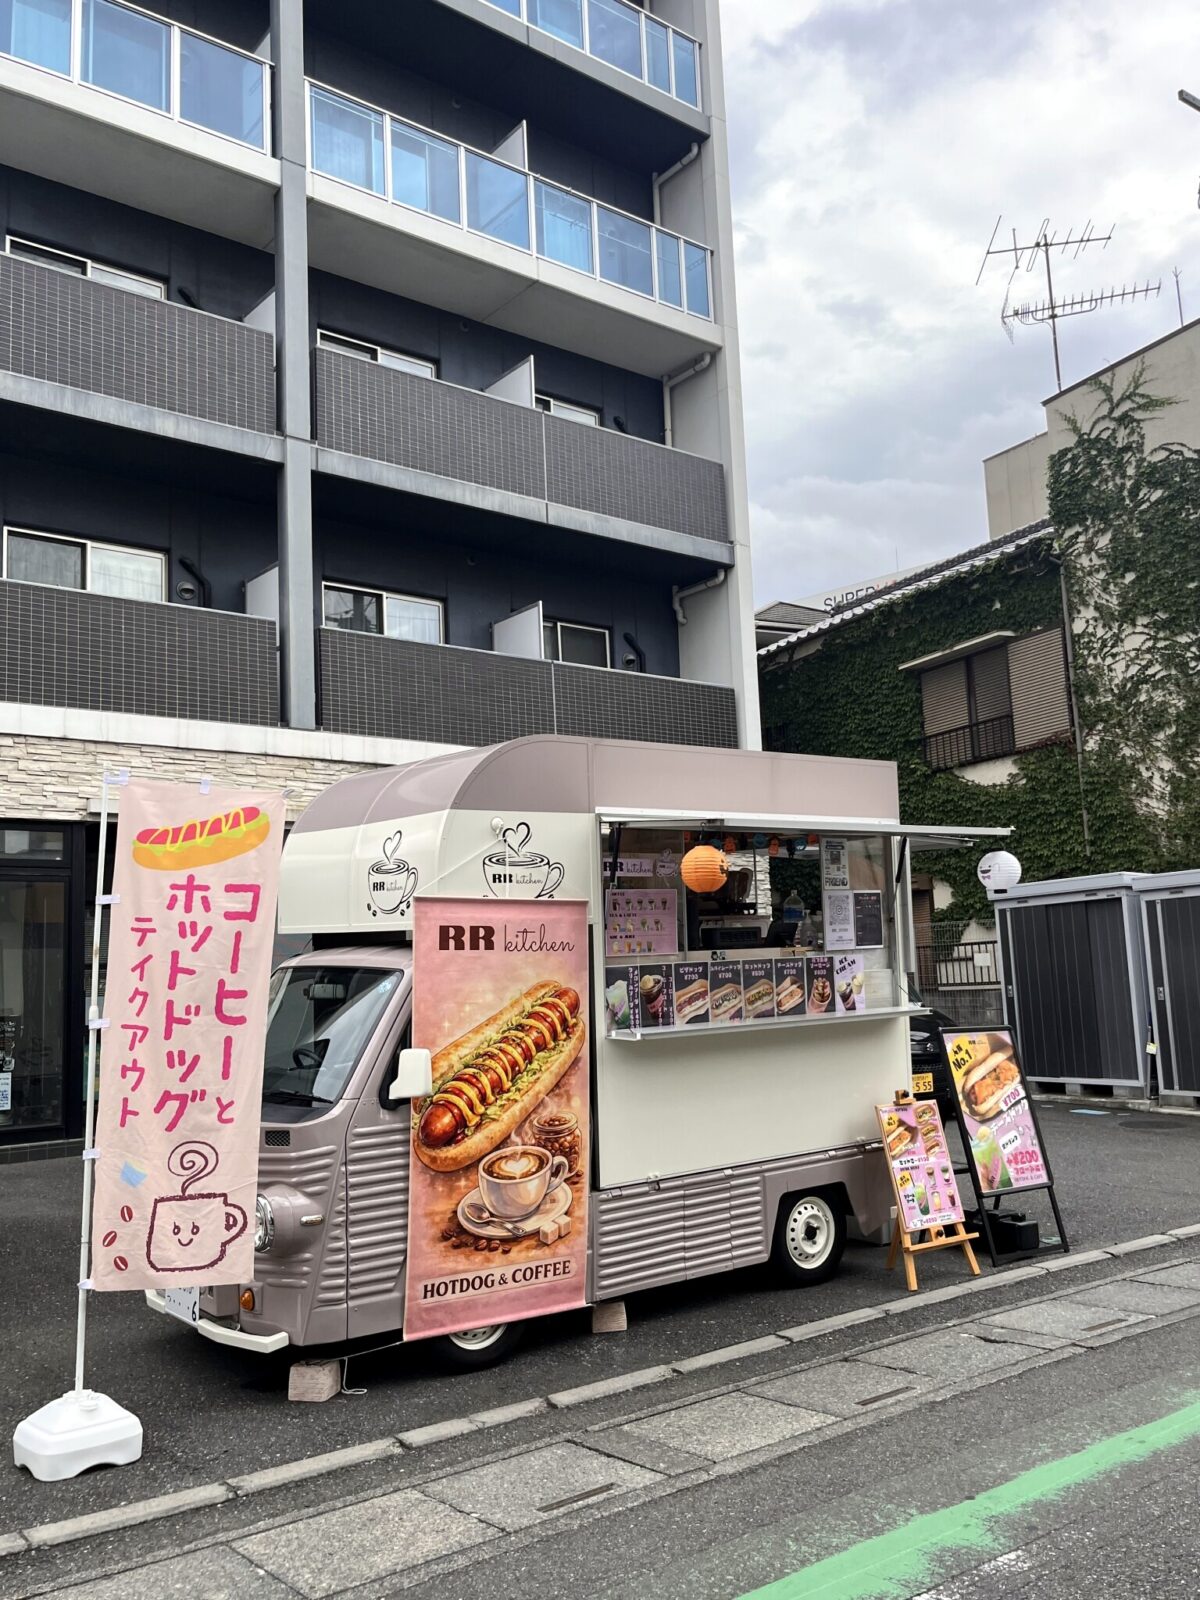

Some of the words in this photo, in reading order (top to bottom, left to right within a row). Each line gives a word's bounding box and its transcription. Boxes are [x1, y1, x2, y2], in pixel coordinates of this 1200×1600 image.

[626, 861, 652, 874] kitchen
[373, 881, 385, 892] RR
[386, 881, 403, 892] kitchen
[492, 873, 513, 884] RR
[515, 873, 544, 885] kitchen
[439, 925, 496, 951] RR
[504, 923, 575, 953] kitchen
[835, 959, 857, 975] CREAM
[838, 956, 848, 966] ICE
[153, 874, 213, 1132] ホットドッグ
[214, 883, 261, 1125] コーヒーと
[119, 916, 158, 1128] テイクアウト
[952, 1049, 973, 1072] No.1
[1002, 1088, 1021, 1107] ¥700
[423, 1273, 495, 1300] HOTDOG
[498, 1273, 509, 1286] &
[511, 1260, 571, 1284] COFFEE
